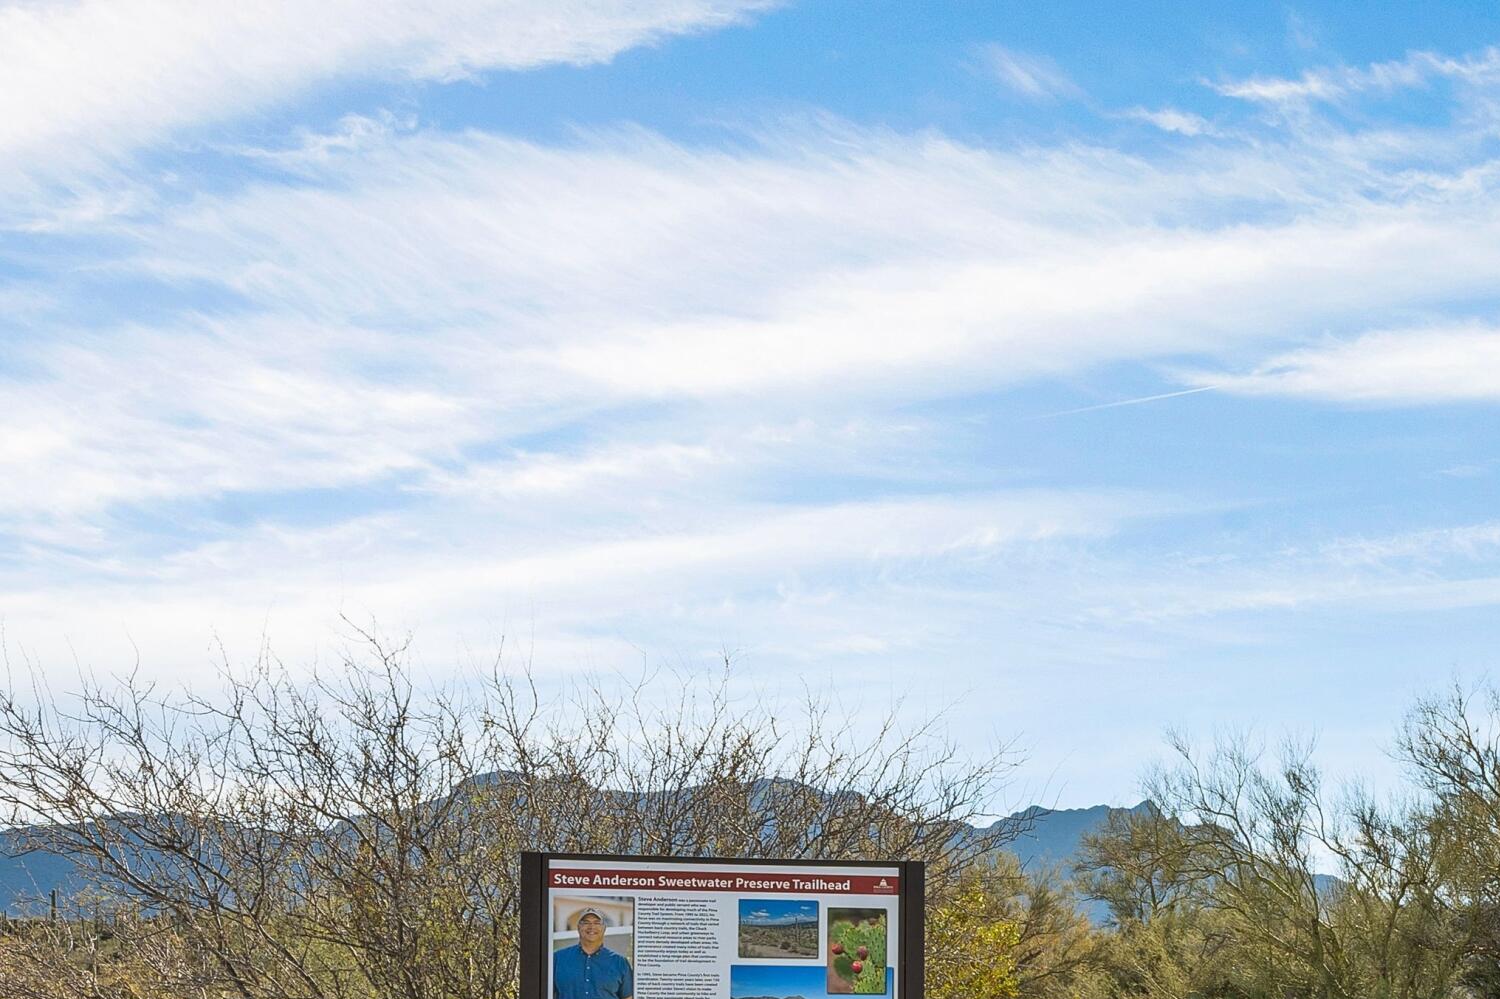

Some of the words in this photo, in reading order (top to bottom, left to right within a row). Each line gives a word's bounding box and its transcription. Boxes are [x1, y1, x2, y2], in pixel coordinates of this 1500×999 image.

[554, 873, 590, 885] Steve
[593, 874, 656, 887] Anderson
[658, 876, 733, 889] Sweetwater
[736, 877, 790, 889] Preserve
[792, 878, 850, 891] Trailhead
